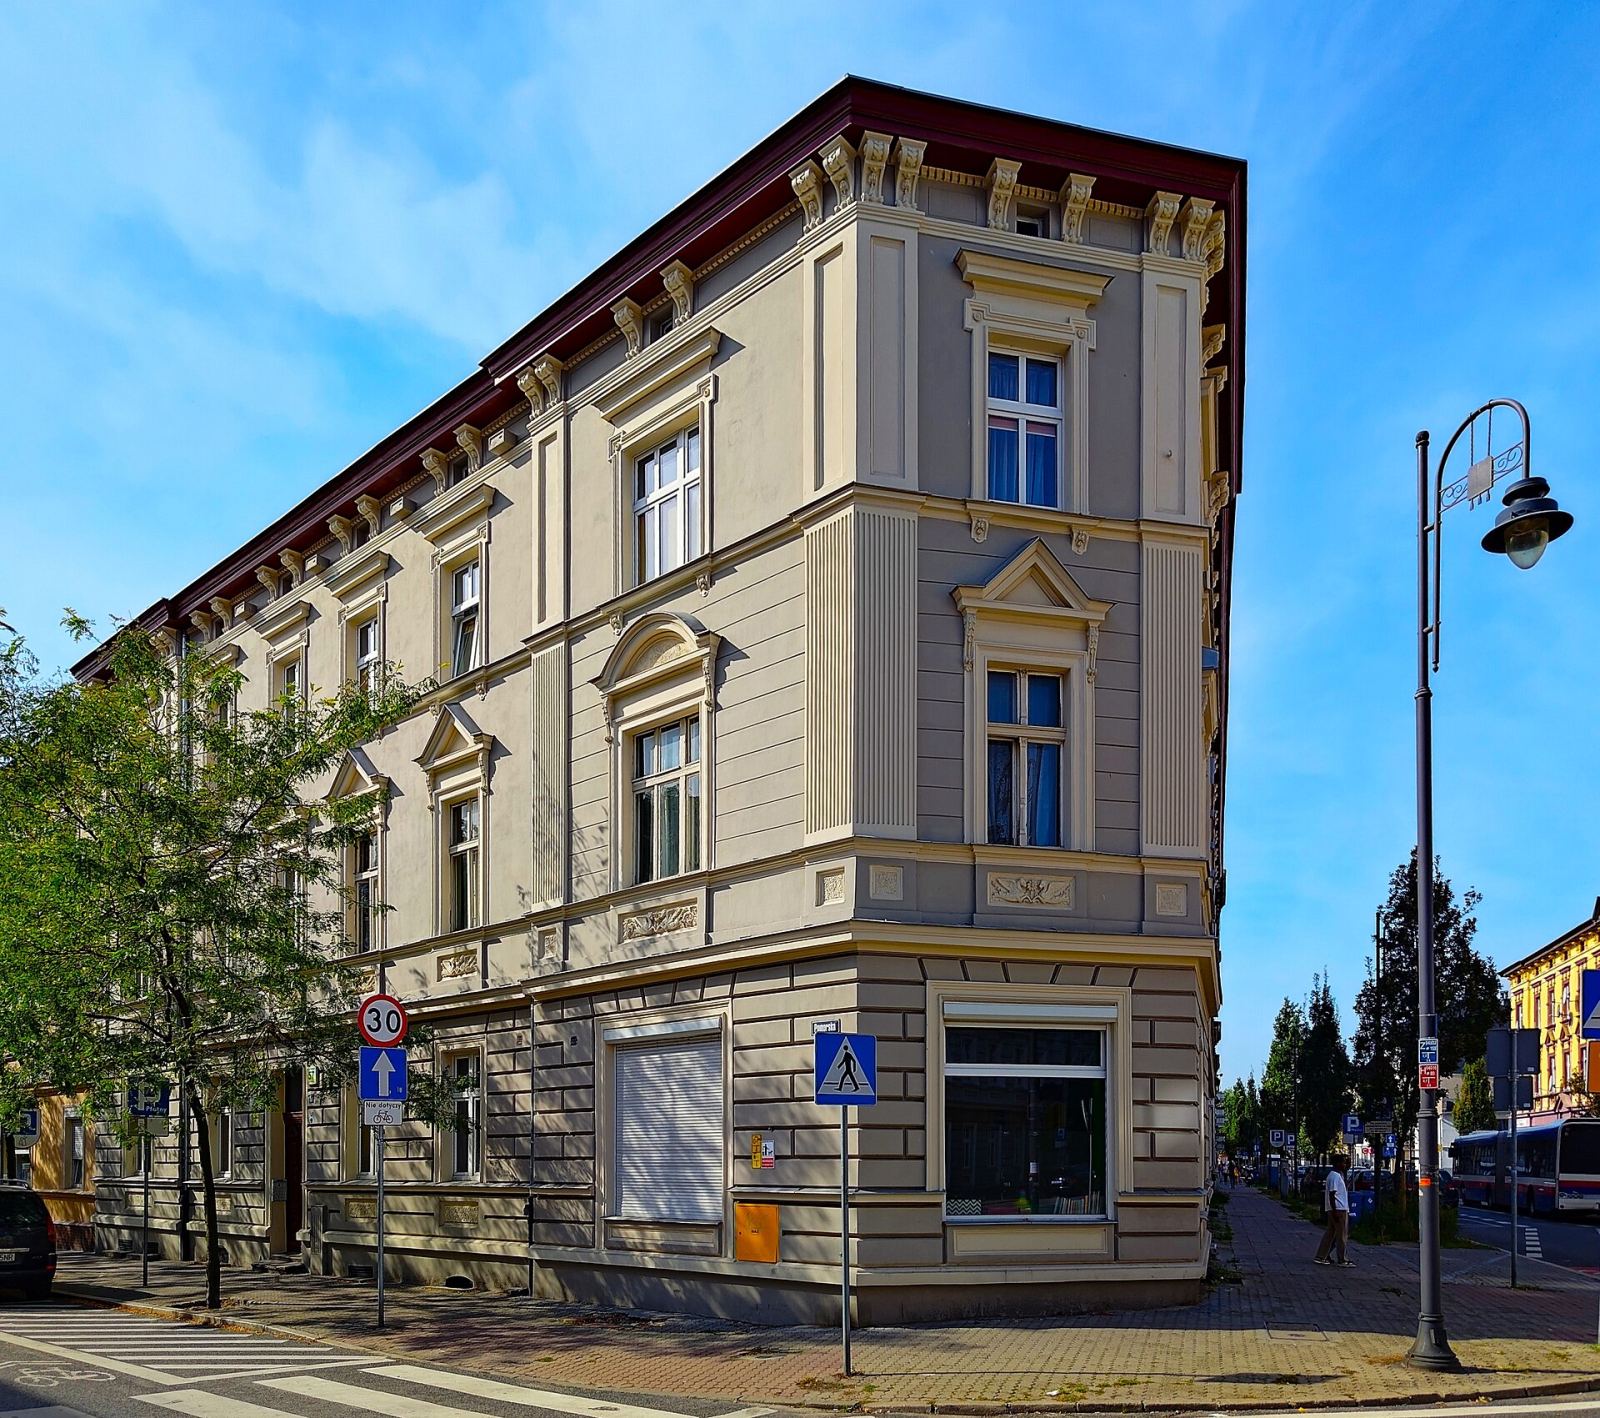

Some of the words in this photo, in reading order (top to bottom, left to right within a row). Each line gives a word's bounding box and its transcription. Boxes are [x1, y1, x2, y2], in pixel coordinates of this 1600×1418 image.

[366, 1008, 401, 1033] 30
[378, 1102, 401, 1111] dotyczy
[1347, 1116, 1359, 1132] P
[1273, 1132, 1281, 1141] P
[1287, 1134, 1295, 1145] P
